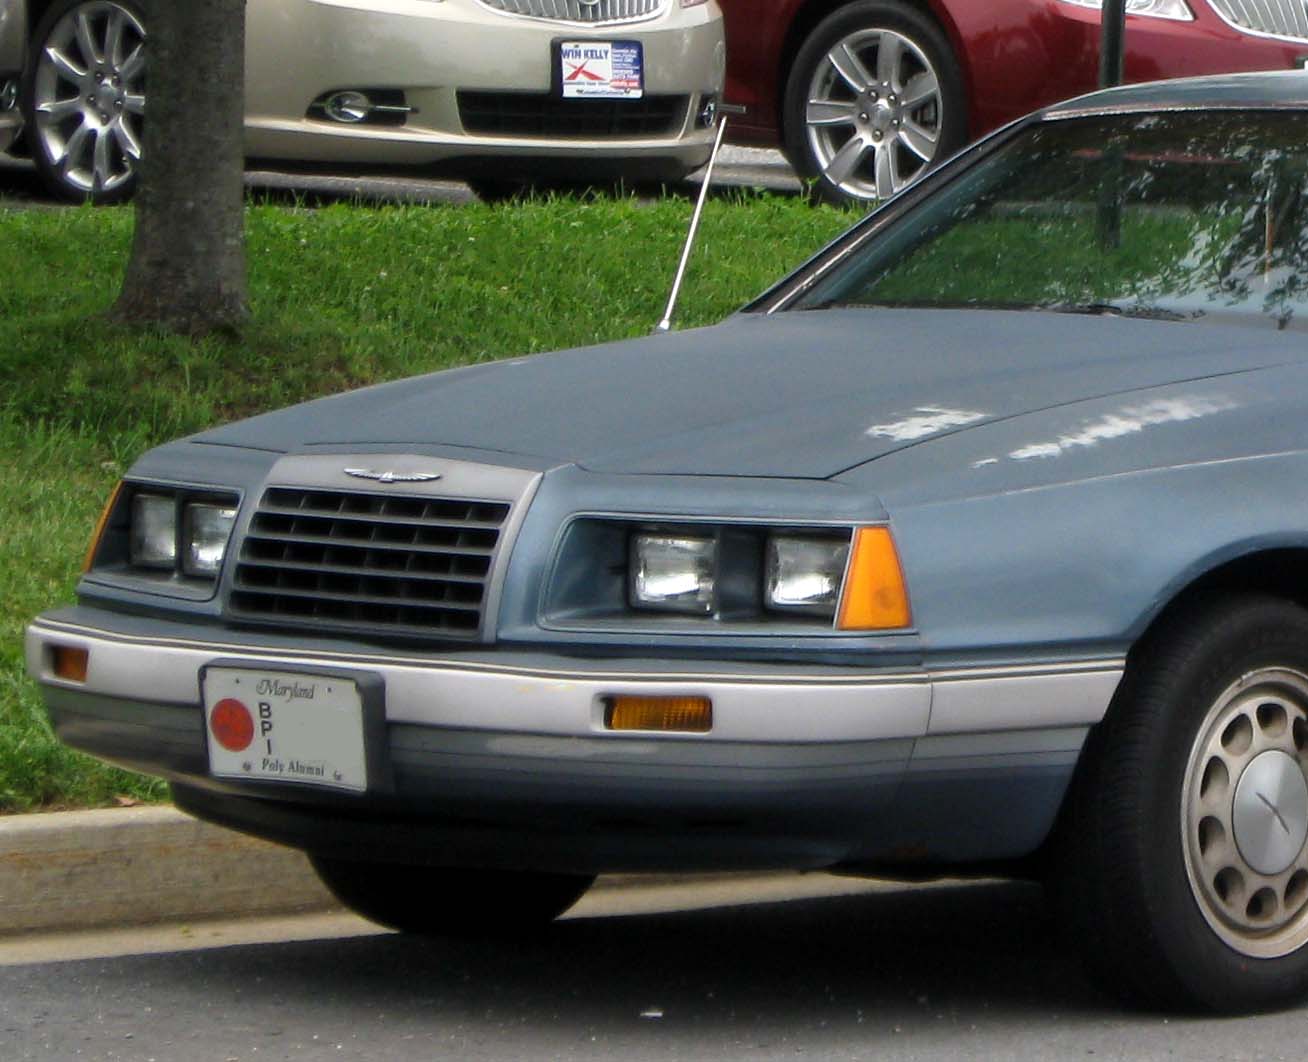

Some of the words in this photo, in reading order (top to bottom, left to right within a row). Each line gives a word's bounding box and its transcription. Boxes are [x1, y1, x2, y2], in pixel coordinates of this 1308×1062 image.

[561, 49, 581, 59] WIN
[584, 49, 609, 59] KELLY
[256, 680, 315, 703] Maryland
[262, 758, 285, 773] Poly
[288, 760, 325, 777] Alumni
